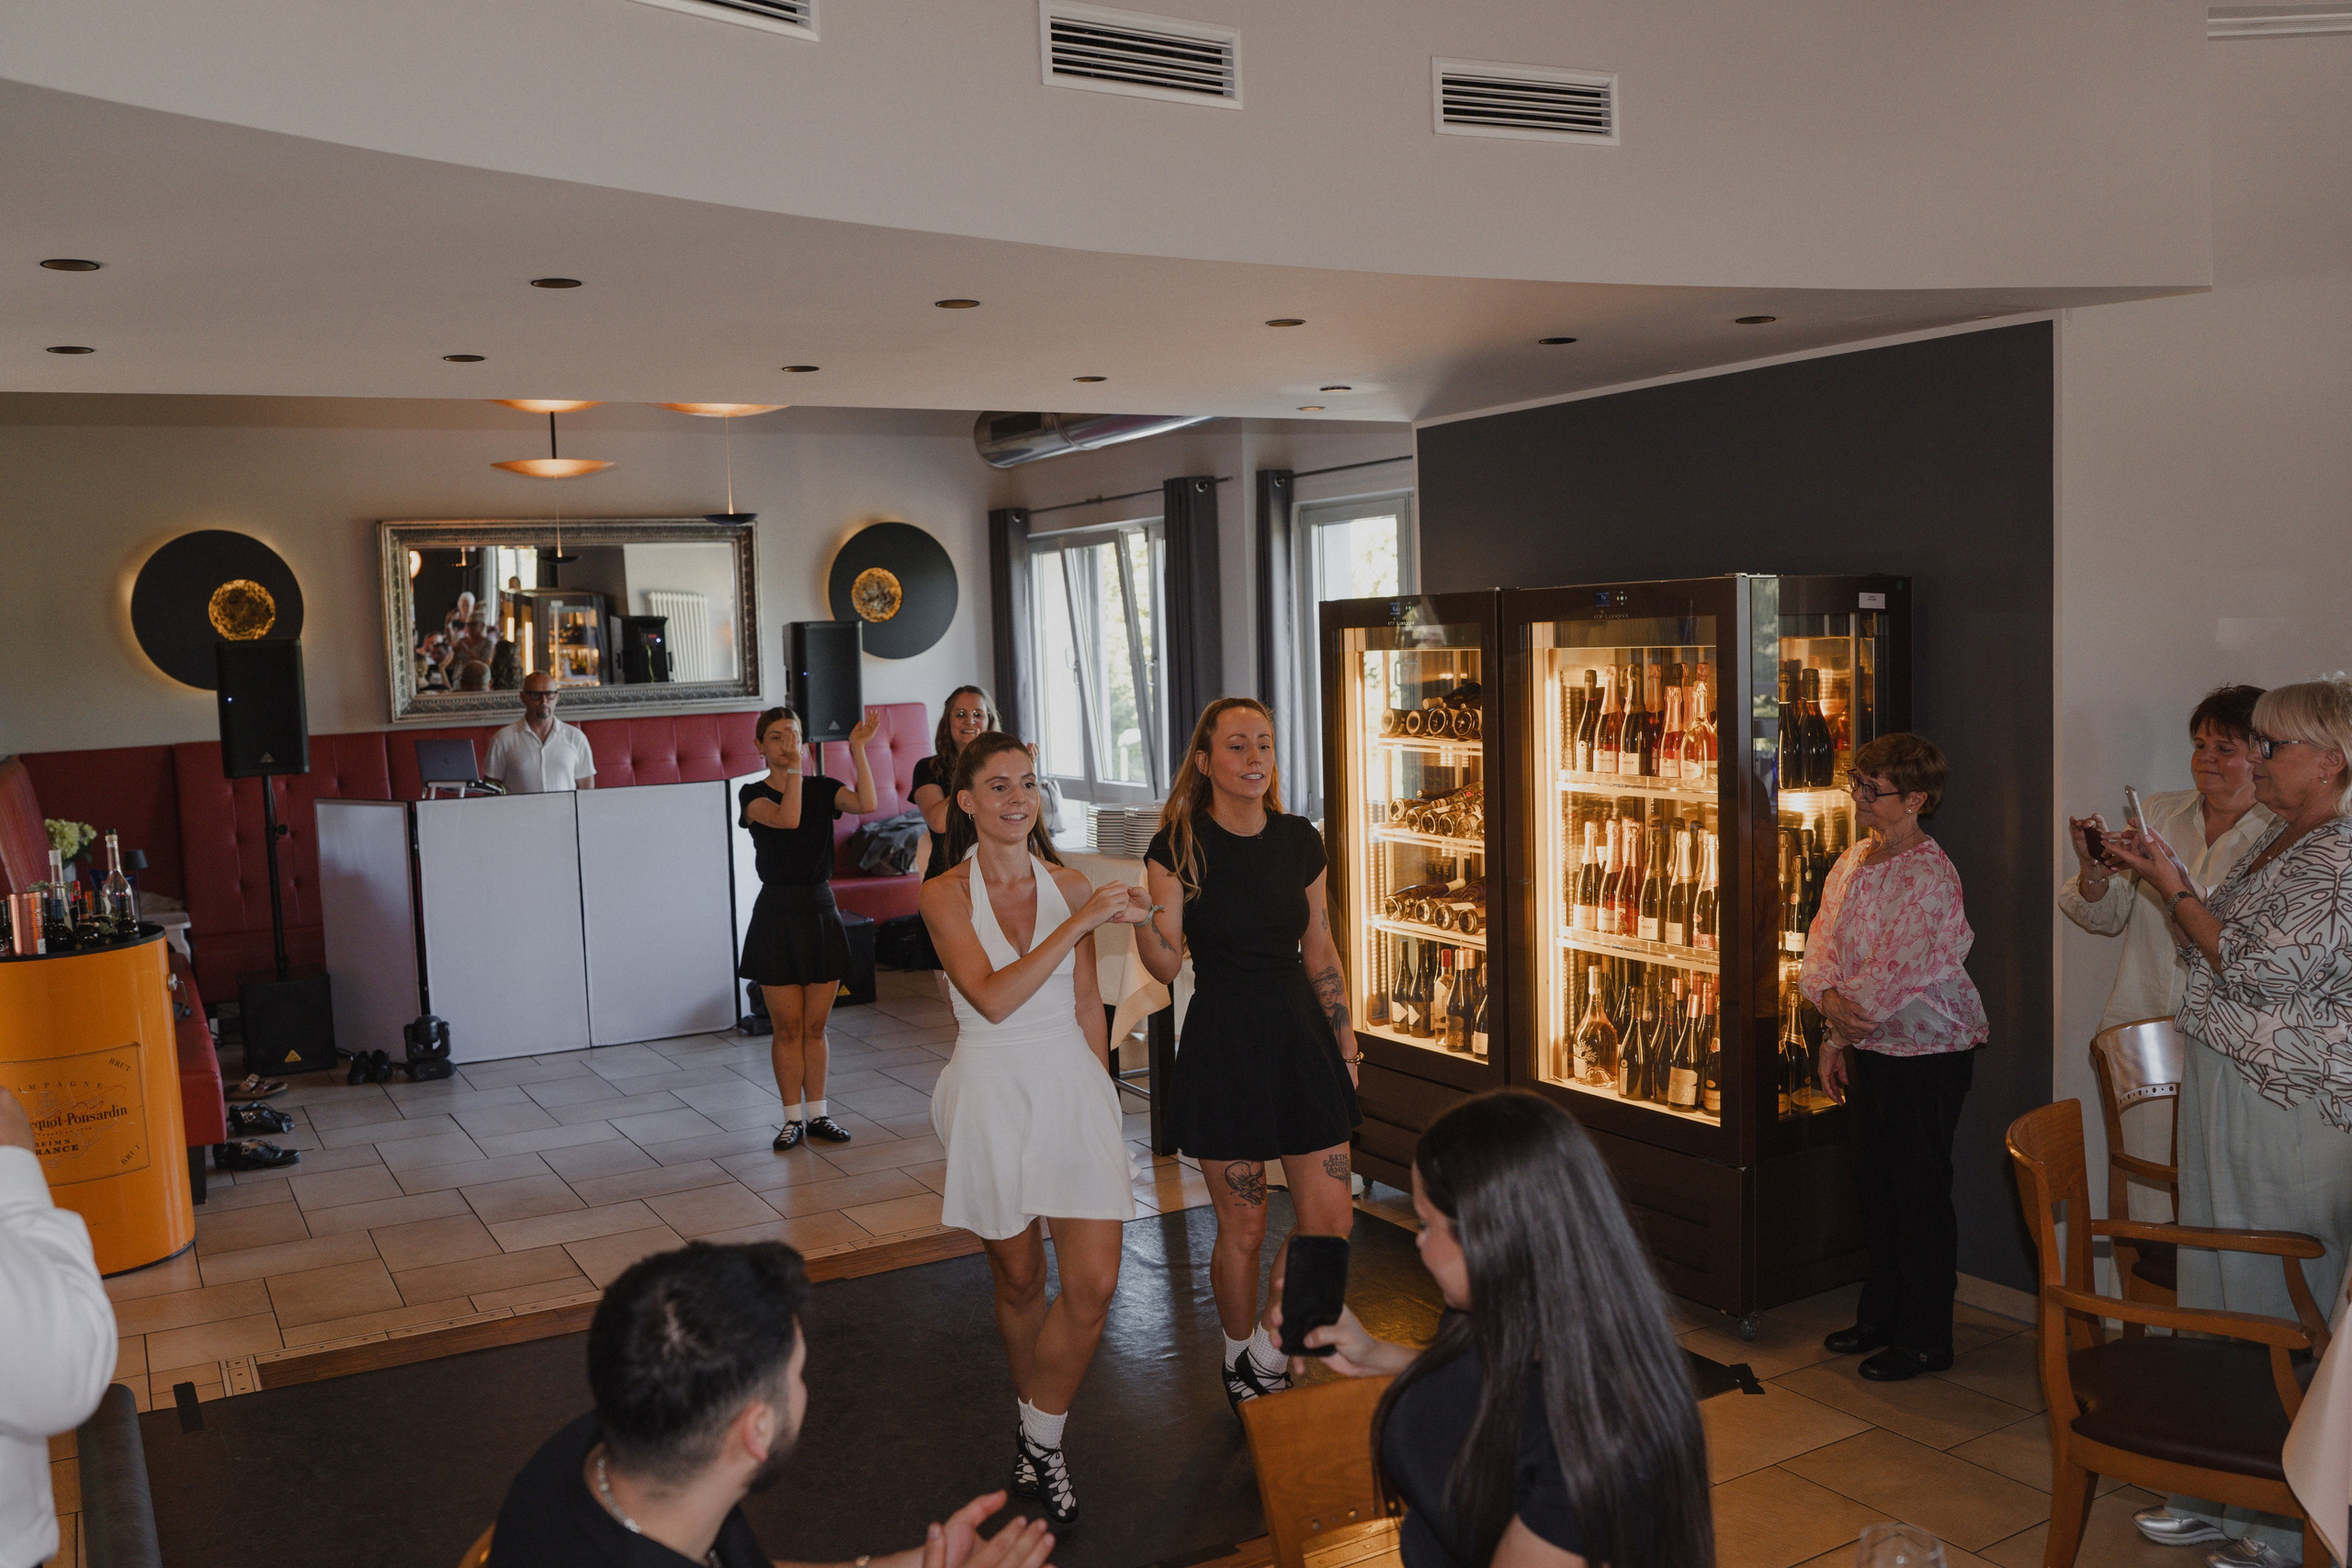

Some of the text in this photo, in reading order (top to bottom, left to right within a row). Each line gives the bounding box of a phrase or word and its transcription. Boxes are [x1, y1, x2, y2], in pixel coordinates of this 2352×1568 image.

[108, 1057, 132, 1072] BRUT
[17, 1080, 103, 1093] AMPAGNE
[67, 1104, 128, 1126] Ponsardin
[35, 1138, 71, 1147] REIMS
[35, 1144, 79, 1156] RANCE
[120, 1143, 141, 1166] BRUT
